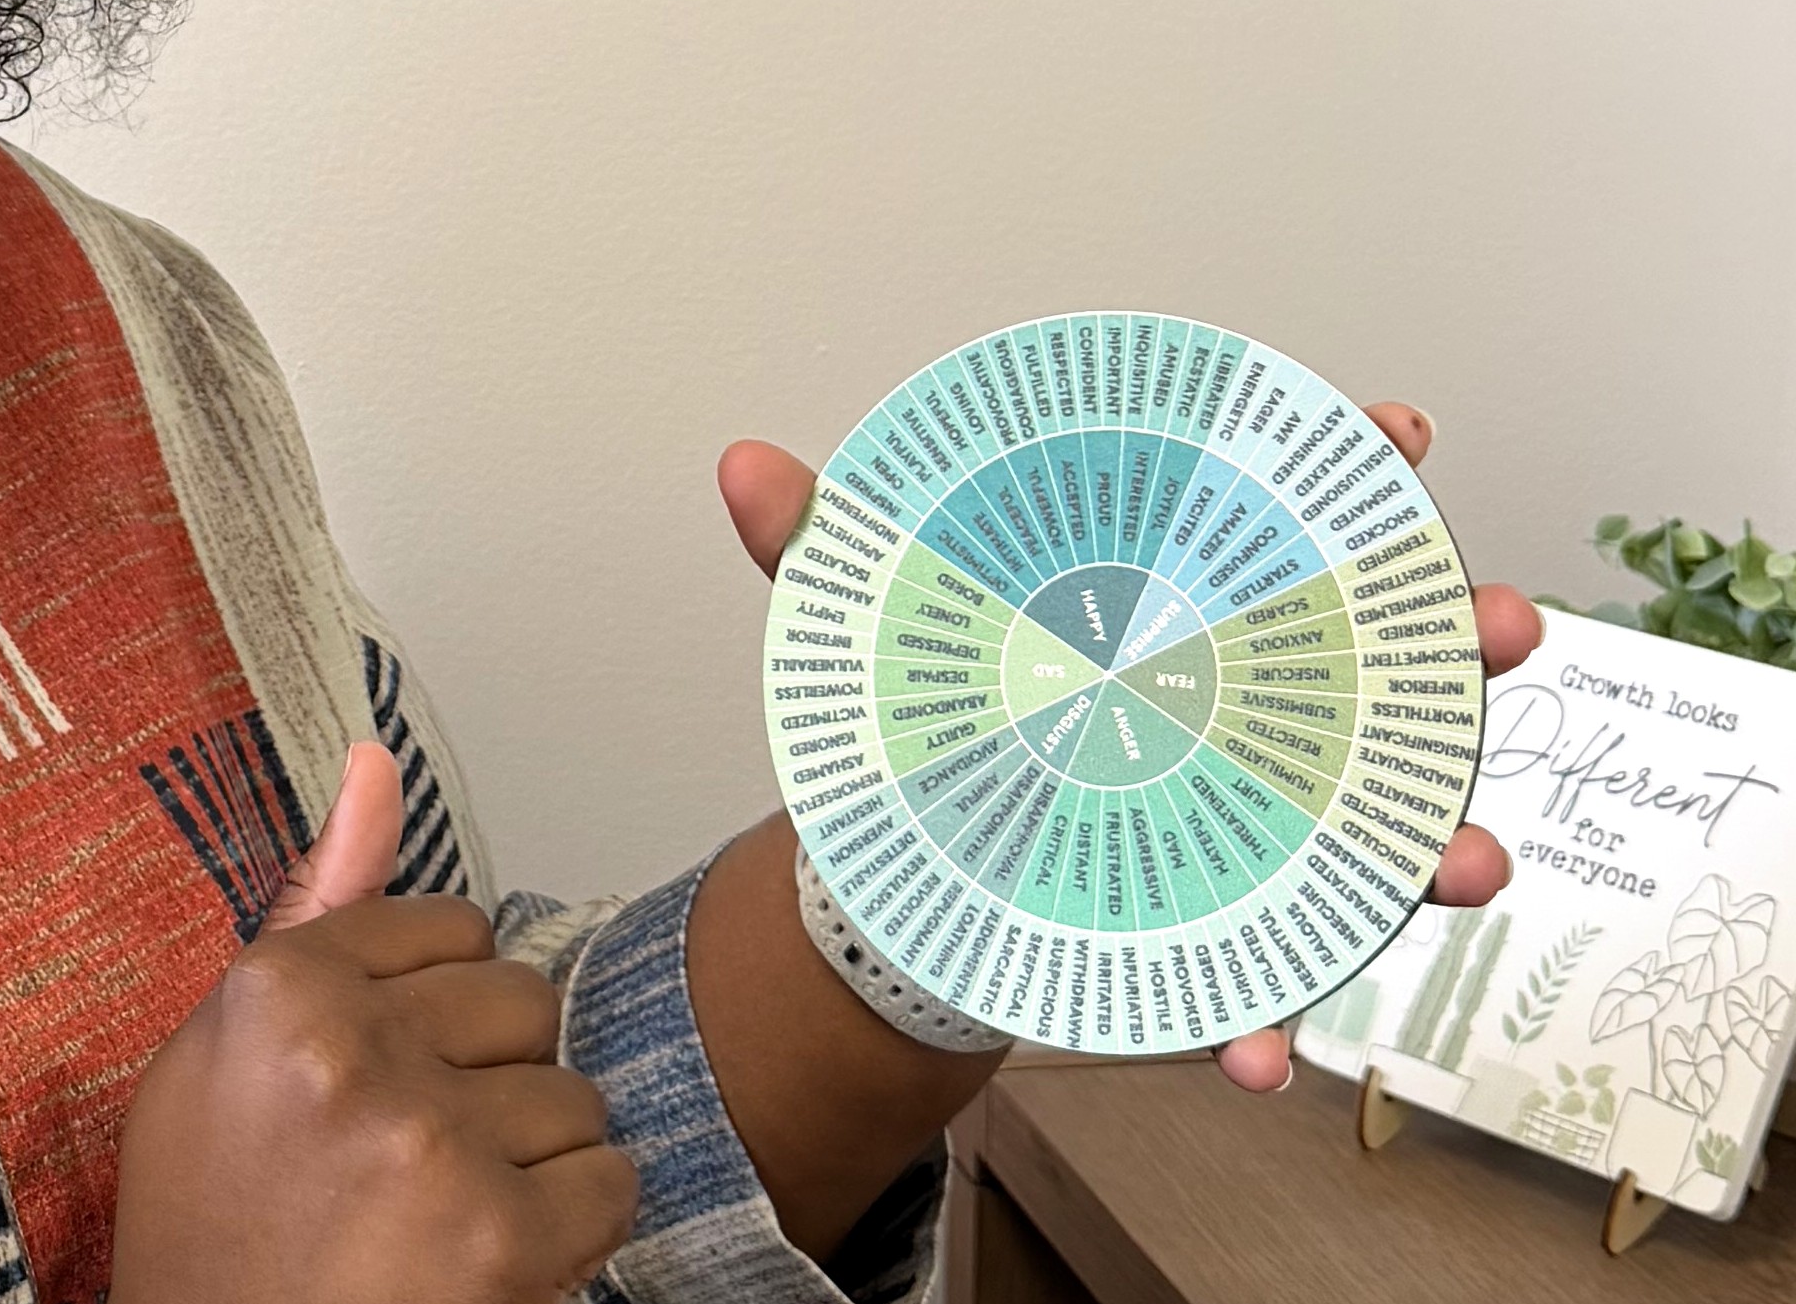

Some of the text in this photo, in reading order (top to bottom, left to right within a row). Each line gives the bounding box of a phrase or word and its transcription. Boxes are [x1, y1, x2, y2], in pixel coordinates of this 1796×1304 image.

[995, 340, 1035, 438] COURAGEOUS
[1022, 345, 1051, 418] FULFILLED
[1051, 332, 1074, 417] RESPECTED
[1079, 327, 1097, 414] CONFIDENT
[1106, 327, 1122, 416] IMPORTANT
[1128, 325, 1152, 415] INQUISITIVE
[1154, 343, 1179, 408] AMUSED
[925, 390, 968, 451] HOPEFUL
[950, 382, 985, 435] LOVING
[967, 352, 1017, 446] PROVOCATIVE
[1219, 362, 1266, 442] ENERGETIC
[1248, 387, 1285, 434] EAGER
[902, 408, 951, 472] SENSITIVE
[1272, 411, 1301, 444] AWE
[1272, 406, 1346, 485] ASTONISHED
[871, 455, 904, 490] OPEN
[885, 430, 932, 483] PLAYFUL
[1295, 429, 1364, 497] PERPLEXED
[1301, 444, 1394, 522] DISILLUSIONED
[845, 472, 902, 518] INSPIRED
[1062, 460, 1085, 541] ACCEPTED
[1097, 473, 1111, 526] PROUD
[1123, 452, 1149, 542] INTERESTED
[1153, 477, 1180, 529] JOYFUL
[1174, 485, 1214, 546] EXCITED
[1329, 480, 1402, 531] DISMAYED
[813, 515, 886, 563] APATHETIC
[1199, 502, 1248, 560] AMAZED
[1345, 506, 1419, 551] SHOCKED
[1357, 532, 1431, 572] TERRIFIED
[804, 546, 870, 582] ISOLATED
[1208, 526, 1277, 588] CONFUSED
[1230, 559, 1299, 606] STARTLED
[1354, 558, 1451, 600] FRIGHTENED
[785, 568, 875, 606] ABANDONED
[796, 601, 845, 624] EMPTY
[937, 573, 985, 607] BORED
[1246, 597, 1309, 625] SCARED
[1355, 585, 1466, 624] OVERWHELMED
[786, 629, 851, 648] INFERIOR
[915, 603, 971, 629] LONELY
[1080, 589, 1107, 641] HAPPY
[1124, 600, 1181, 660] SURPRISE
[1250, 629, 1323, 653] ANXIOUS
[1378, 618, 1457, 640] WORRIED
[772, 659, 864, 672] VULNERABLE
[897, 634, 980, 660] DEPRESSED
[1033, 663, 1065, 678] SAD
[1252, 668, 1329, 681] INSECURE
[1362, 649, 1480, 667] INCOMPETENT
[775, 683, 863, 700] POWERLESS
[907, 670, 968, 683] DESPAIR
[1156, 672, 1195, 689] FEAR
[1389, 679, 1464, 694] INFERIOR
[1560, 664, 1739, 732] Growth looks
[781, 706, 867, 730] VICTIMIZED
[893, 694, 988, 720] ABANDONED
[1041, 695, 1091, 754] DISGUST
[1240, 691, 1336, 719] SUBMISSIVE
[1372, 702, 1474, 727] WORTHLESS
[790, 731, 856, 756] IGNORED
[927, 722, 976, 750] GUILTY
[1111, 707, 1141, 760] ANGER
[1246, 720, 1323, 756] REJECTED
[1360, 724, 1476, 762] INSIGNIFICANT
[790, 769, 883, 816] REMORSEFUL
[793, 753, 864, 784] ASHAMED
[918, 738, 999, 794] AVOIDANCE
[1226, 739, 1315, 794] HUMILIATED
[1358, 747, 1464, 791] INADEQUATE
[1480, 684, 1779, 848] Different
[819, 797, 884, 840] HESITANT
[956, 774, 999, 814] AWFUL
[963, 766, 1040, 863] DISAPPOINTED
[1192, 776, 1265, 862] THREATENED
[1230, 777, 1272, 812] HURT
[1363, 778, 1450, 820] ALIENATED
[828, 815, 894, 867] AVERSION
[1036, 815, 1068, 887] CRITICAL
[1073, 823, 1092, 892] DISTANT
[1129, 808, 1164, 910] AGGRESSIVE
[1163, 831, 1186, 869] MAD
[1186, 809, 1230, 876] HATEFUL
[1341, 820, 1421, 877] RIDICULED
[1571, 818, 1625, 852] for
[839, 830, 917, 897] DETESTABLE
[860, 852, 928, 922] REVULSION
[1106, 811, 1121, 916] FRUSTRATED
[1315, 832, 1417, 912] EMBARRASSED
[1519, 840, 1656, 897] everyone
[884, 872, 942, 937] REVOLTED
[1297, 881, 1364, 949] INSECURE
[1307, 854, 1392, 934] DEVASTATED
[900, 880, 963, 968] REPUGNANT
[929, 904, 979, 978] LOATHING
[1258, 907, 1318, 992] RESENTFUL
[1286, 902, 1338, 967] JEALOUS
[979, 925, 1021, 1015] SARCASTIC
[1006, 933, 1043, 1019] SKEPTICAL
[1037, 937, 1066, 1037] SUSPICIOUS
[1196, 945, 1230, 1023] ENRAGED
[1219, 938, 1258, 1010] FURIOUS
[1240, 925, 1286, 1003] VIOLATED
[1066, 938, 1089, 1048] WITHDRAWN
[1097, 952, 1112, 1036] IRRITATED
[1122, 947, 1144, 1044] INFURIATED
[1149, 961, 1172, 1032] HOSTILE
[1169, 945, 1203, 1039] PROVOKED
